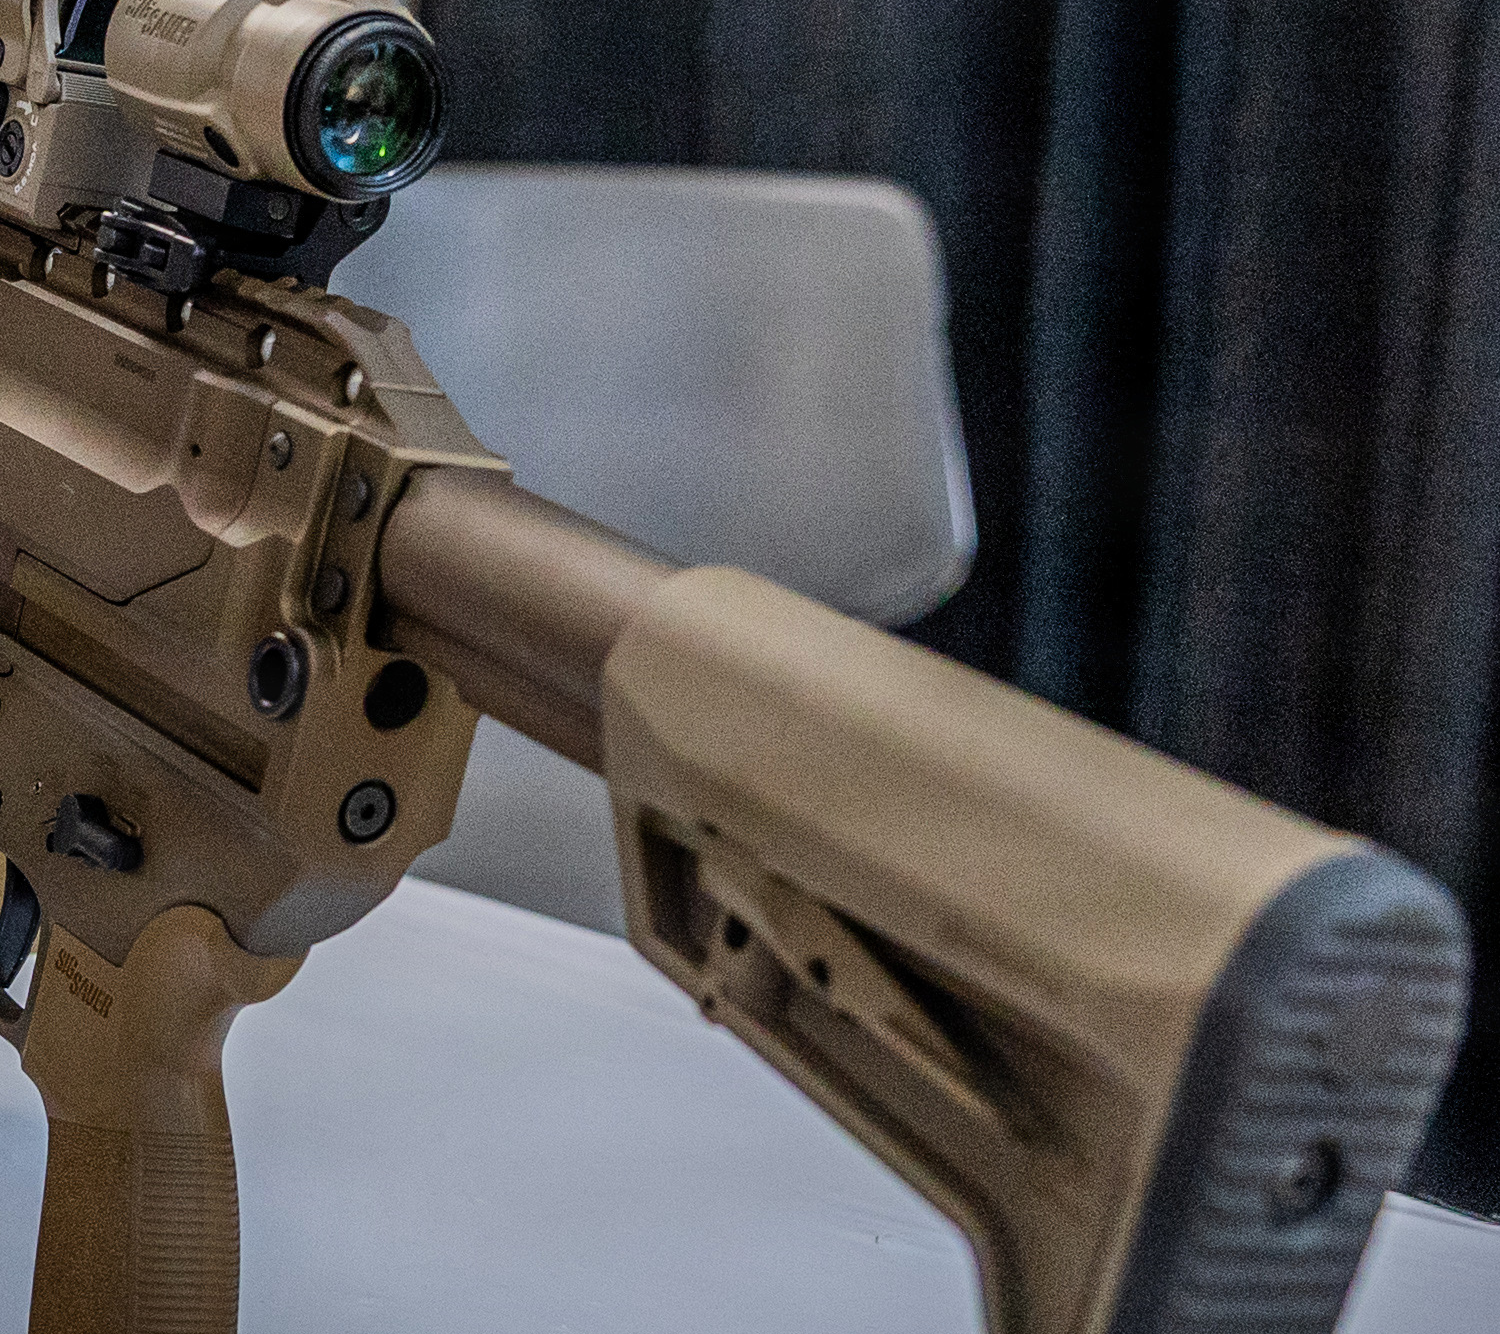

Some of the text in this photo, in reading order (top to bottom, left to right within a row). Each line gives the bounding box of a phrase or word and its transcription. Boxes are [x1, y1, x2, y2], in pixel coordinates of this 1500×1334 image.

[140, 8, 198, 47] SAUER
[53, 947, 79, 979] SIG
[68, 971, 114, 1019] SAUER
